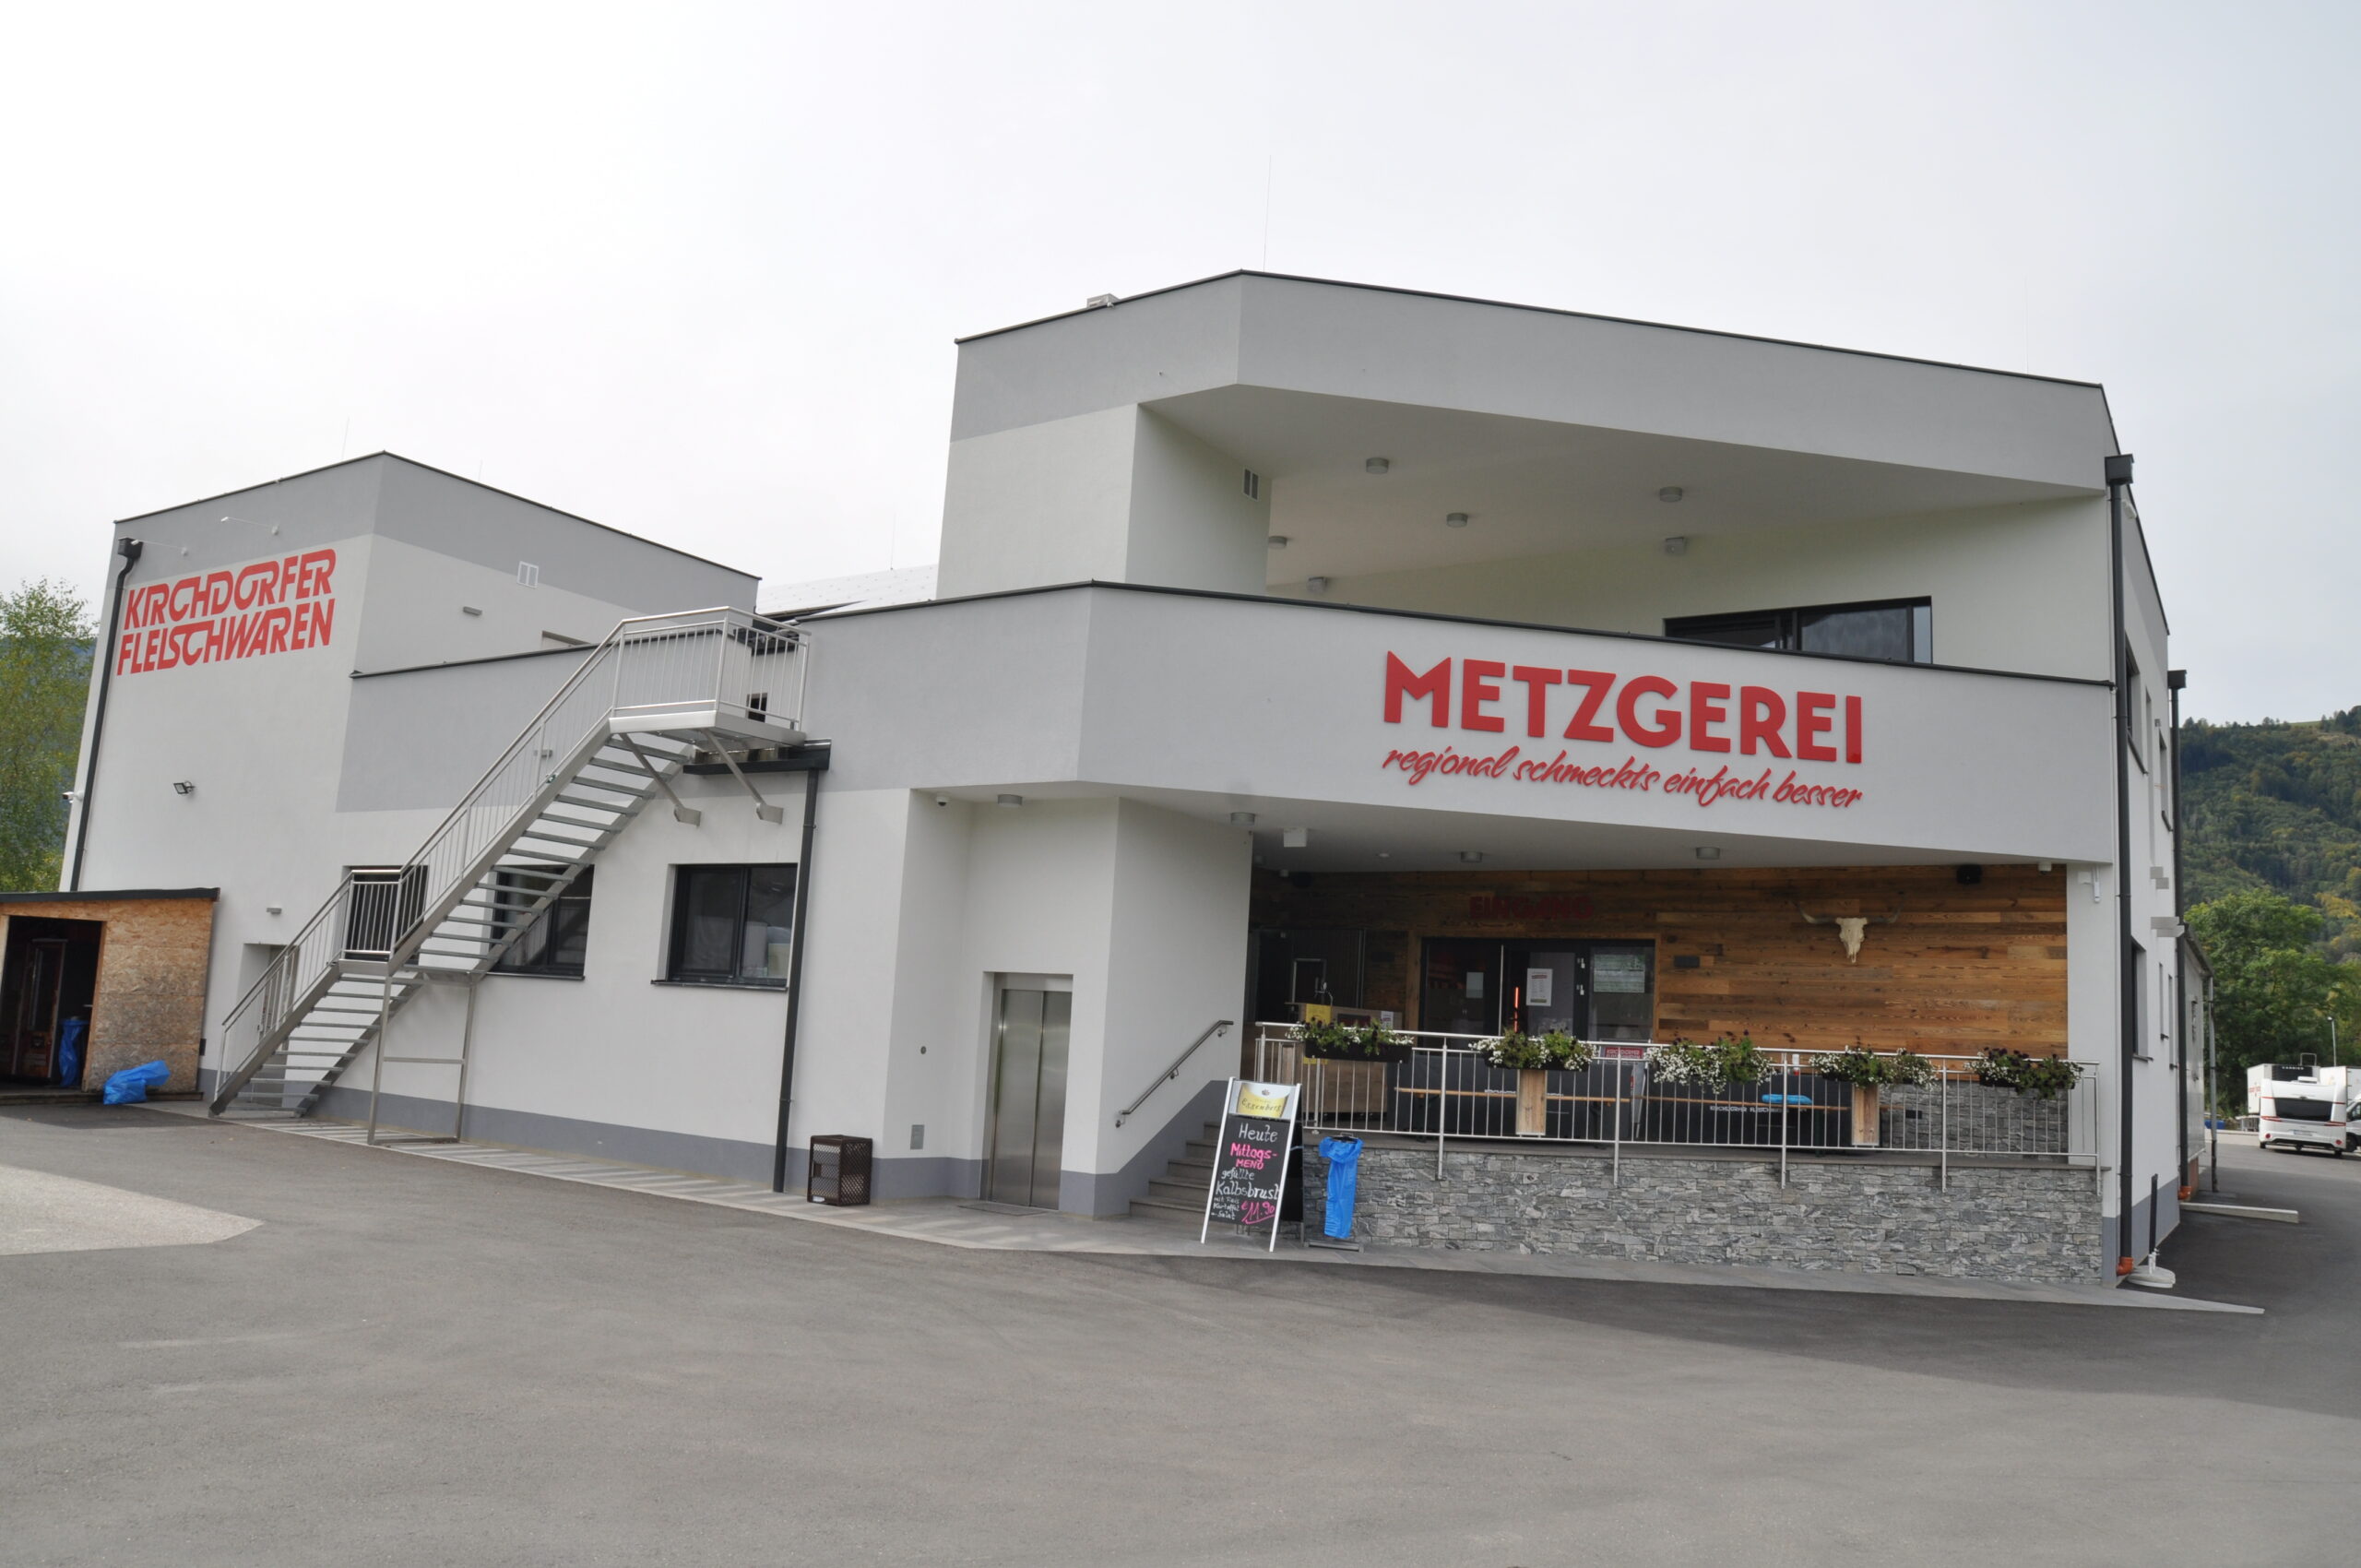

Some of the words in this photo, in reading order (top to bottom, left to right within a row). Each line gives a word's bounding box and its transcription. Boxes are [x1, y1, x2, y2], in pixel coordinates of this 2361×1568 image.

[124, 549, 336, 630] KIRCHDORFER
[117, 599, 335, 675] FLEISCHWAREN
[1384, 651, 1862, 764] METZGEREI
[1382, 746, 1520, 785] regional
[1514, 756, 1660, 792] schmeckts
[1664, 766, 1770, 806] einfach
[1772, 768, 1863, 808] besser
[1469, 896, 1595, 920] EINGANG
[1239, 1123, 1278, 1143] Heute
[1215, 1181, 1280, 1200] Kalbsbrust
